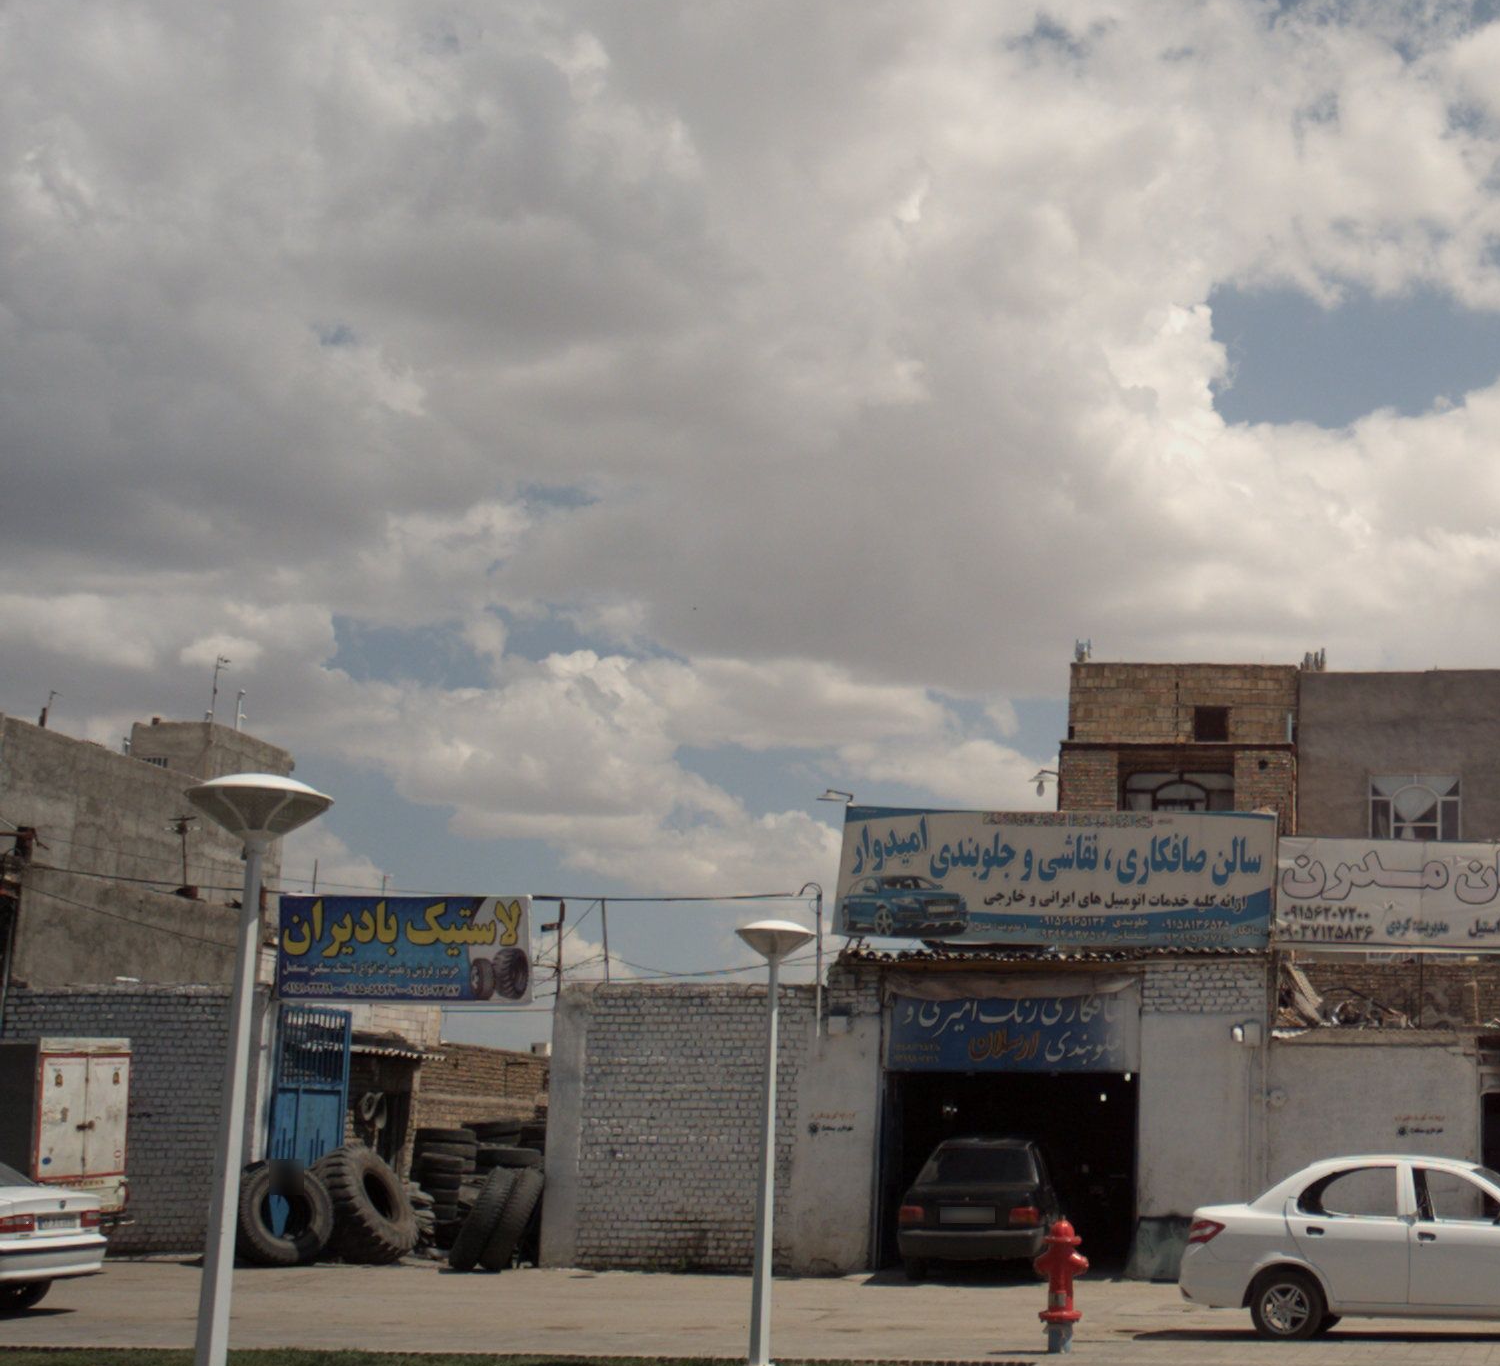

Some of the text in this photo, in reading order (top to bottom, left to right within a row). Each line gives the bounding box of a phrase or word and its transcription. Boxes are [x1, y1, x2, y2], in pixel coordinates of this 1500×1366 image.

[852, 815, 929, 875] امیدوار
[930, 835, 1017, 881] جلوبندی
[1038, 833, 1099, 881] نقاشی
[1020, 854, 1032, 881] و
[1211, 835, 1262, 887] سالن
[1281, 849, 1450, 901] مدرن
[983, 889, 1026, 908] خارجی
[1029, 895, 1036, 907] و
[1039, 891, 1075, 908] ایرانی
[1078, 892, 1102, 908] های
[1148, 894, 1189, 908] خدمات
[1193, 894, 1218, 910] کلیه
[282, 899, 522, 958] لاستیک بادیران
[1468, 918, 1500, 939] استیل
[968, 1028, 1041, 1061] ارسلان
